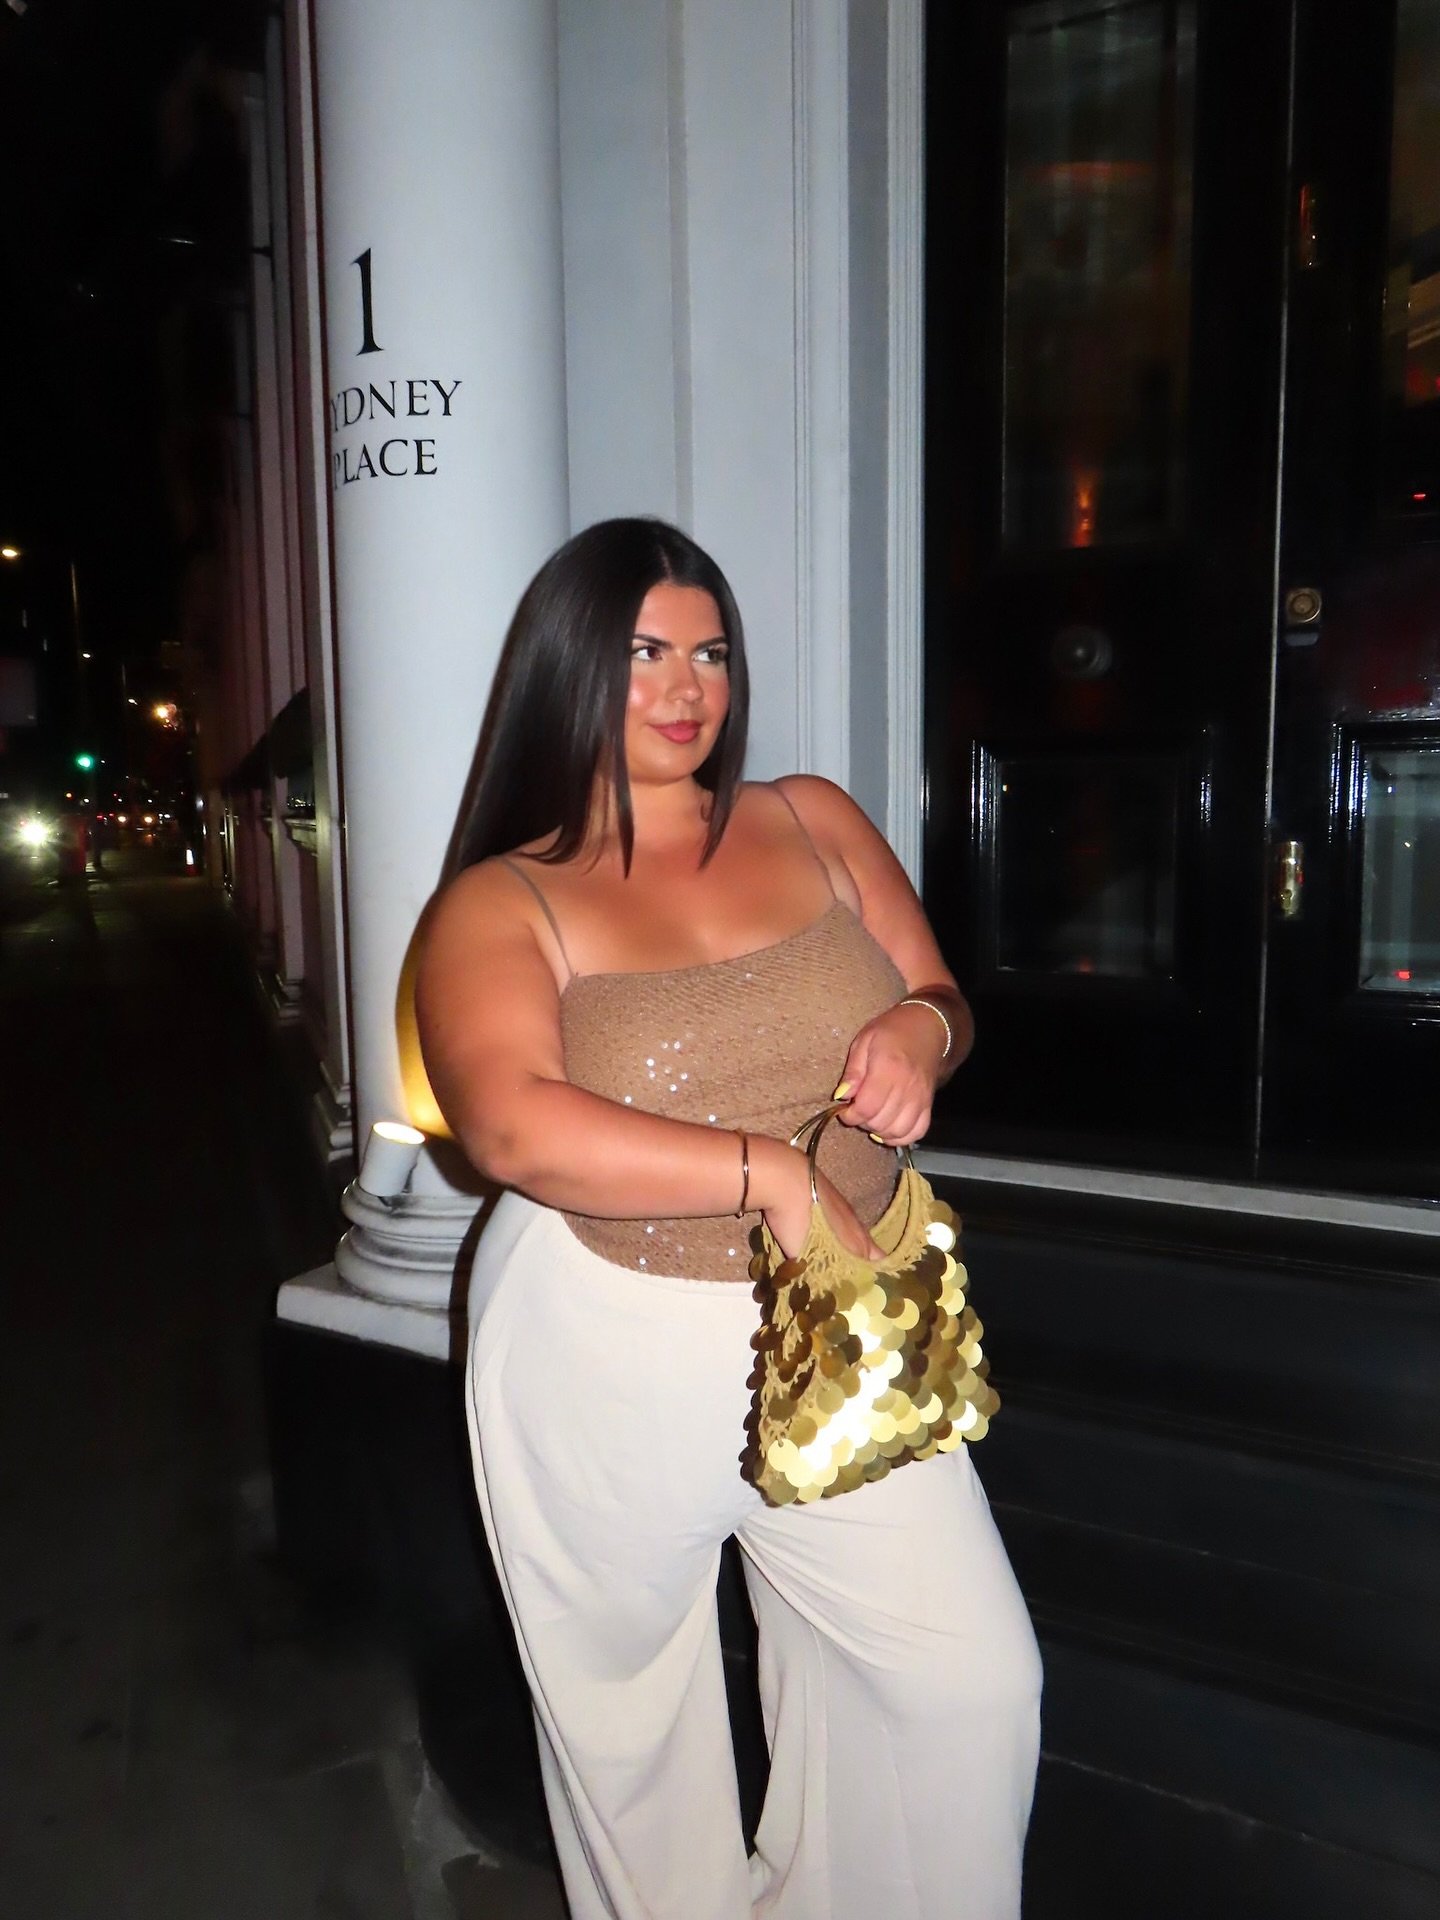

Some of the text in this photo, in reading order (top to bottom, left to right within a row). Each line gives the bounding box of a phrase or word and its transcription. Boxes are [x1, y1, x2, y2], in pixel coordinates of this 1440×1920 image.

[350, 247, 385, 357] 1
[330, 379, 463, 433] YDNEY
[332, 438, 438, 491] PLACE
